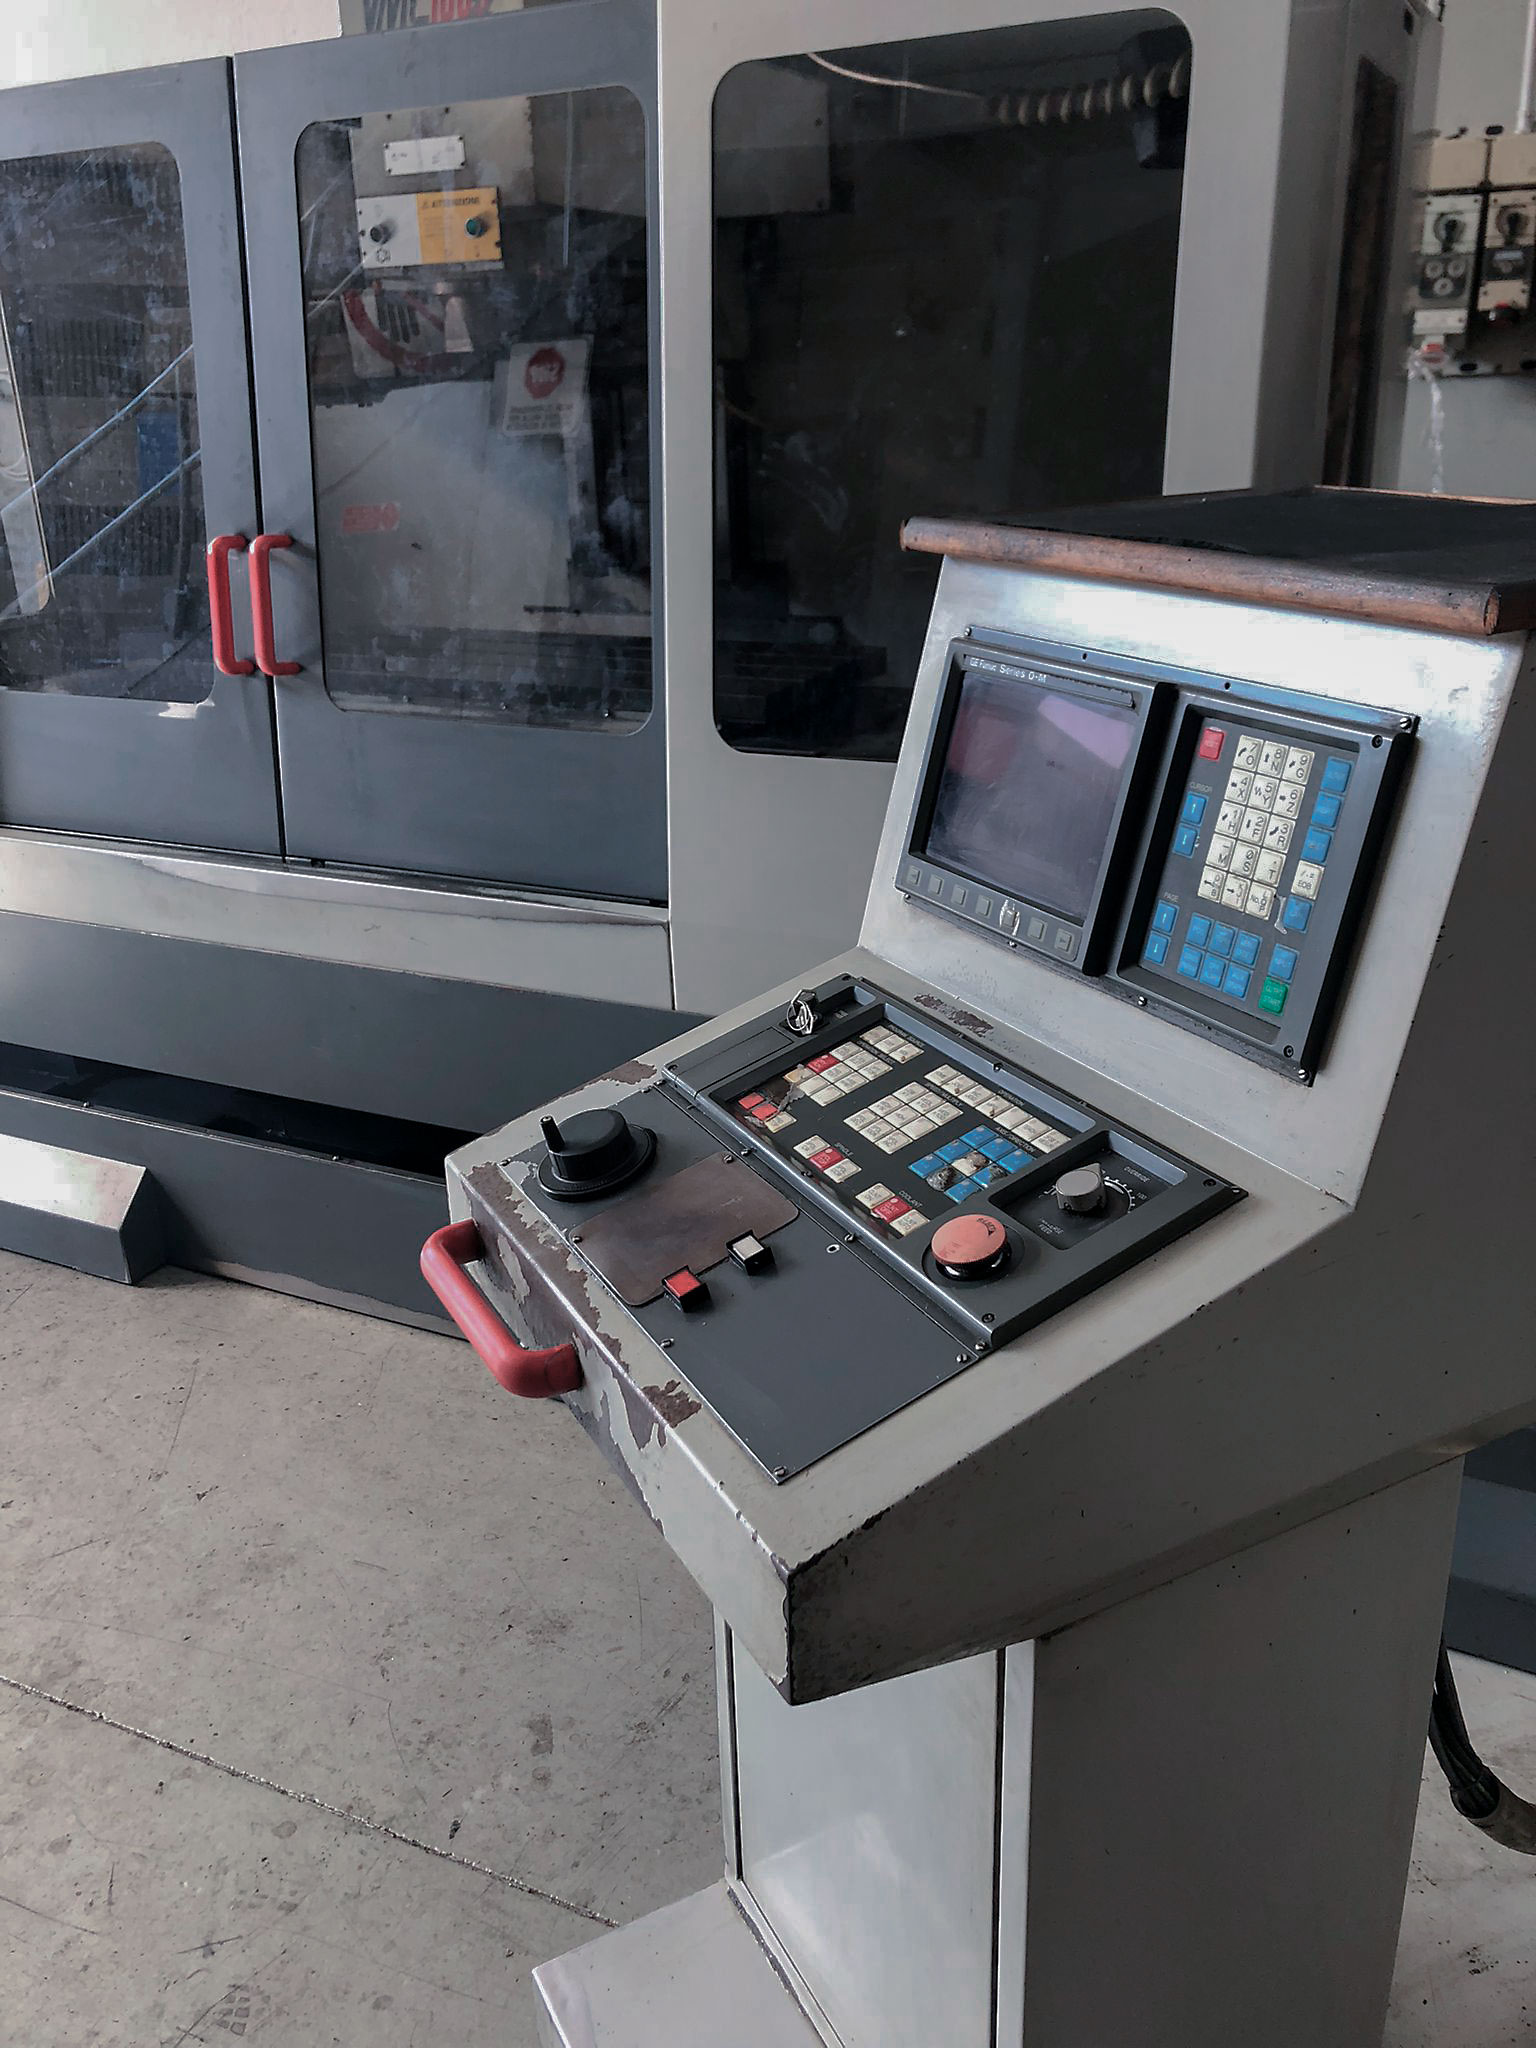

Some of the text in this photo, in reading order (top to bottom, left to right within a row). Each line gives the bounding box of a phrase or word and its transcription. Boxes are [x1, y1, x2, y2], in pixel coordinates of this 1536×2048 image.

[1000, 664, 1026, 678] Series
[1250, 743, 1257, 752] 7
[1275, 748, 1282, 759] 8
[1300, 755, 1308, 765] 9
[1271, 762, 1279, 771] N
[1296, 768, 1304, 778] G
[1241, 777, 1248, 785] 4
[1265, 783, 1272, 792] 5
[1237, 788, 1245, 798] X
[1290, 790, 1298, 800] 6
[1263, 796, 1271, 805] Y
[1287, 802, 1295, 813] Z
[1233, 810, 1239, 818] 1
[1228, 822, 1236, 831] H
[1256, 816, 1264, 827] 2
[1252, 829, 1260, 837] F
[1281, 824, 1289, 834] 3
[1277, 836, 1285, 846] R
[1218, 854, 1227, 864] M
[1243, 863, 1250, 872] S
[1269, 869, 1276, 880] T
[898, 1190, 923, 1208] COOLANT
